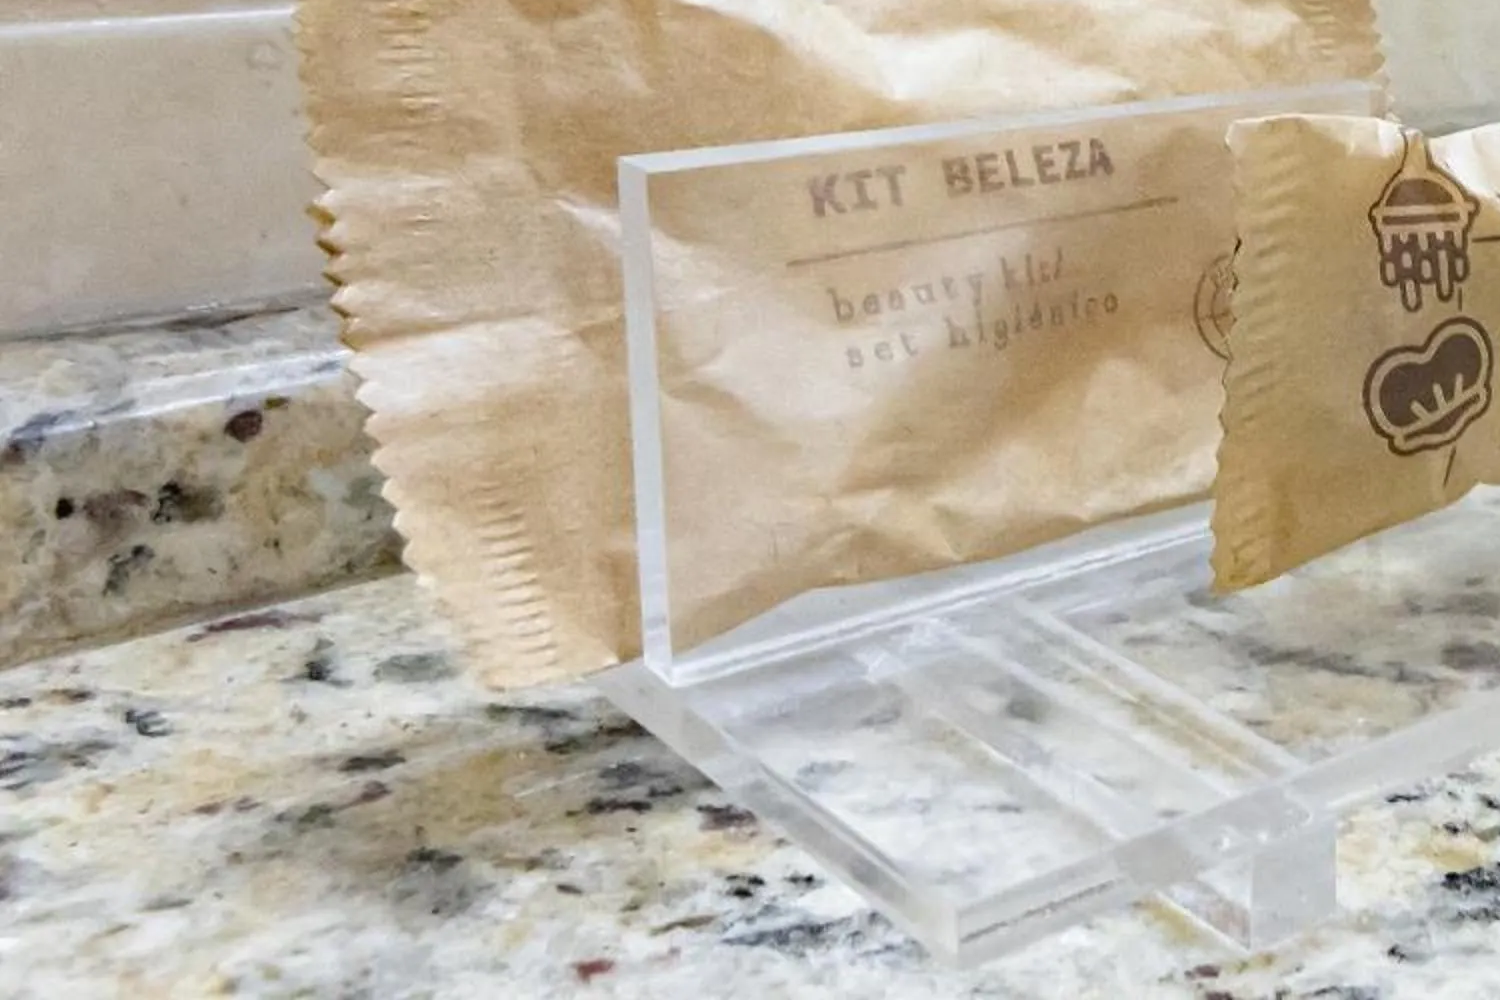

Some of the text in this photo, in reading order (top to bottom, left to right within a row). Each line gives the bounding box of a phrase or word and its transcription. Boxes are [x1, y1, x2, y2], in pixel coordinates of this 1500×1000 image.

[808, 137, 1115, 217] KIT BELEZA
[826, 272, 984, 323] beauty
[846, 333, 918, 368] set
